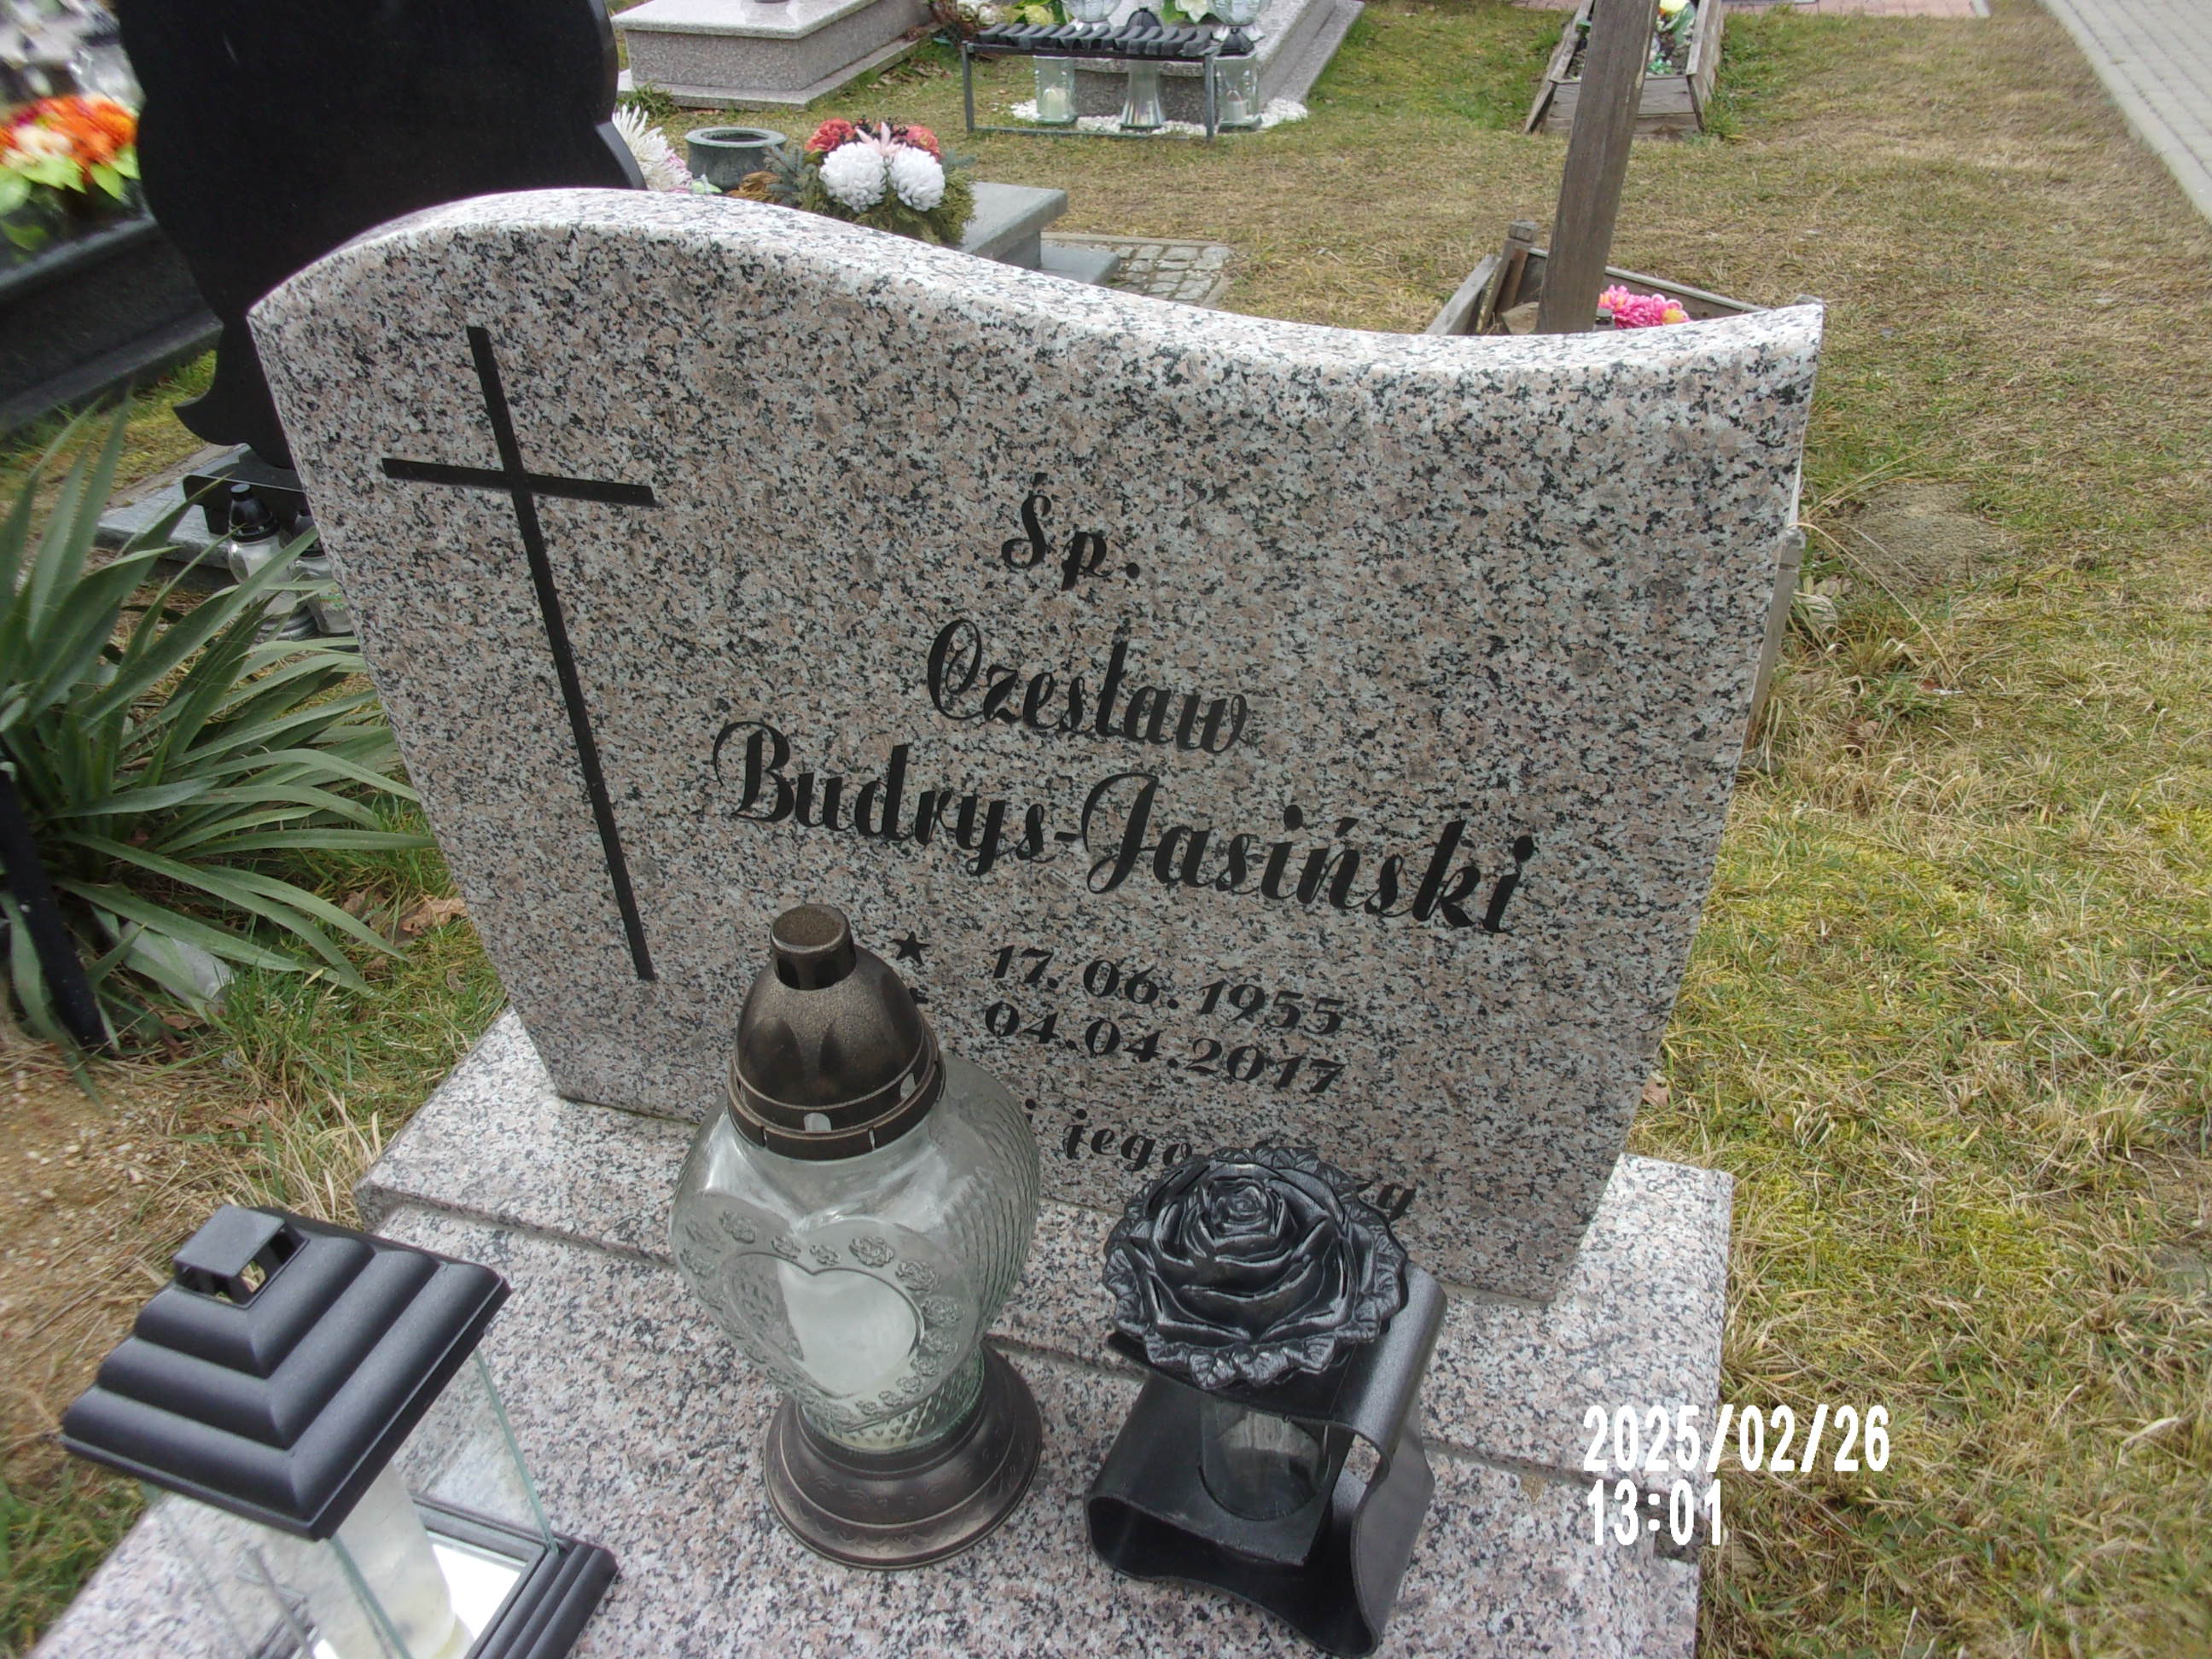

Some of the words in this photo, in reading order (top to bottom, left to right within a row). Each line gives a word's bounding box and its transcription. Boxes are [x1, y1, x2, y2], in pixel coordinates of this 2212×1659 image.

[927, 619, 1251, 754] Czesław
[712, 720, 1535, 934] Budrys-Jasiński
[984, 1000, 1348, 1094] 04.04.2017
[989, 944, 1346, 1036] 17.06.1955
